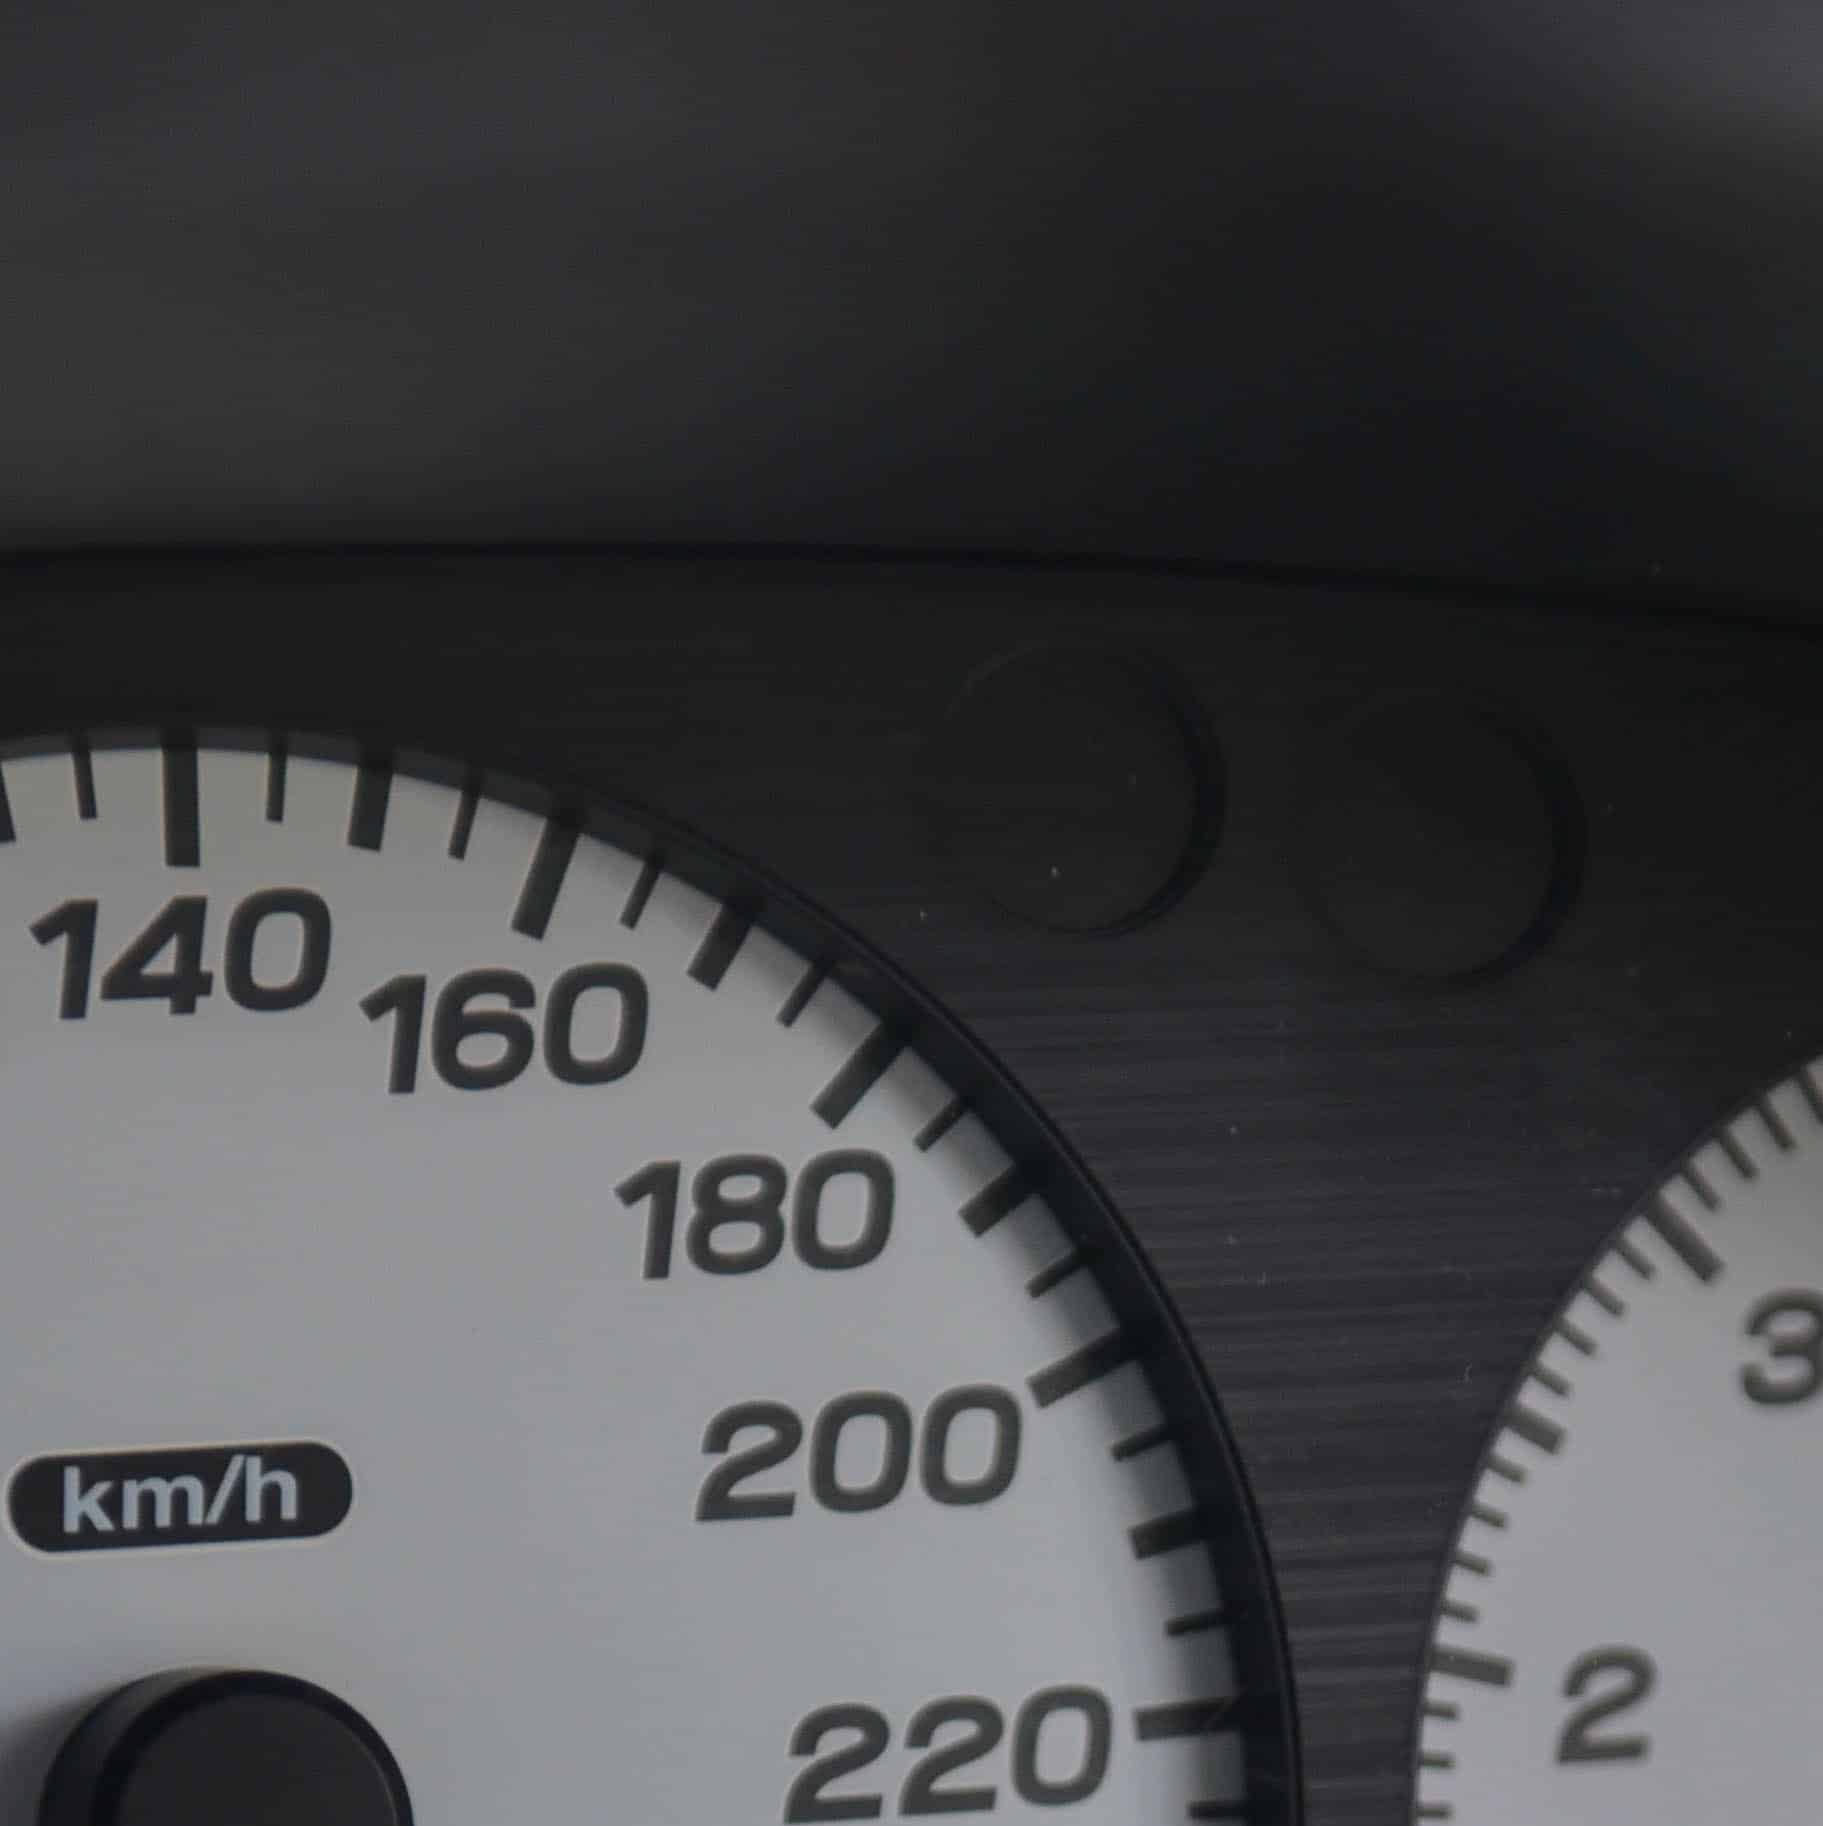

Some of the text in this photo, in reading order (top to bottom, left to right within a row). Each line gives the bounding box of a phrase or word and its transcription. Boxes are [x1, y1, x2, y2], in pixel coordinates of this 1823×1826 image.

[31, 889, 331, 1019] 140
[361, 963, 649, 1094] 160
[616, 1149, 895, 1280] 180
[61, 1454, 299, 1535] km/h
[696, 1386, 1022, 1524] 200
[784, 1686, 1113, 1825] 220
[1555, 1647, 1655, 1765] 2
